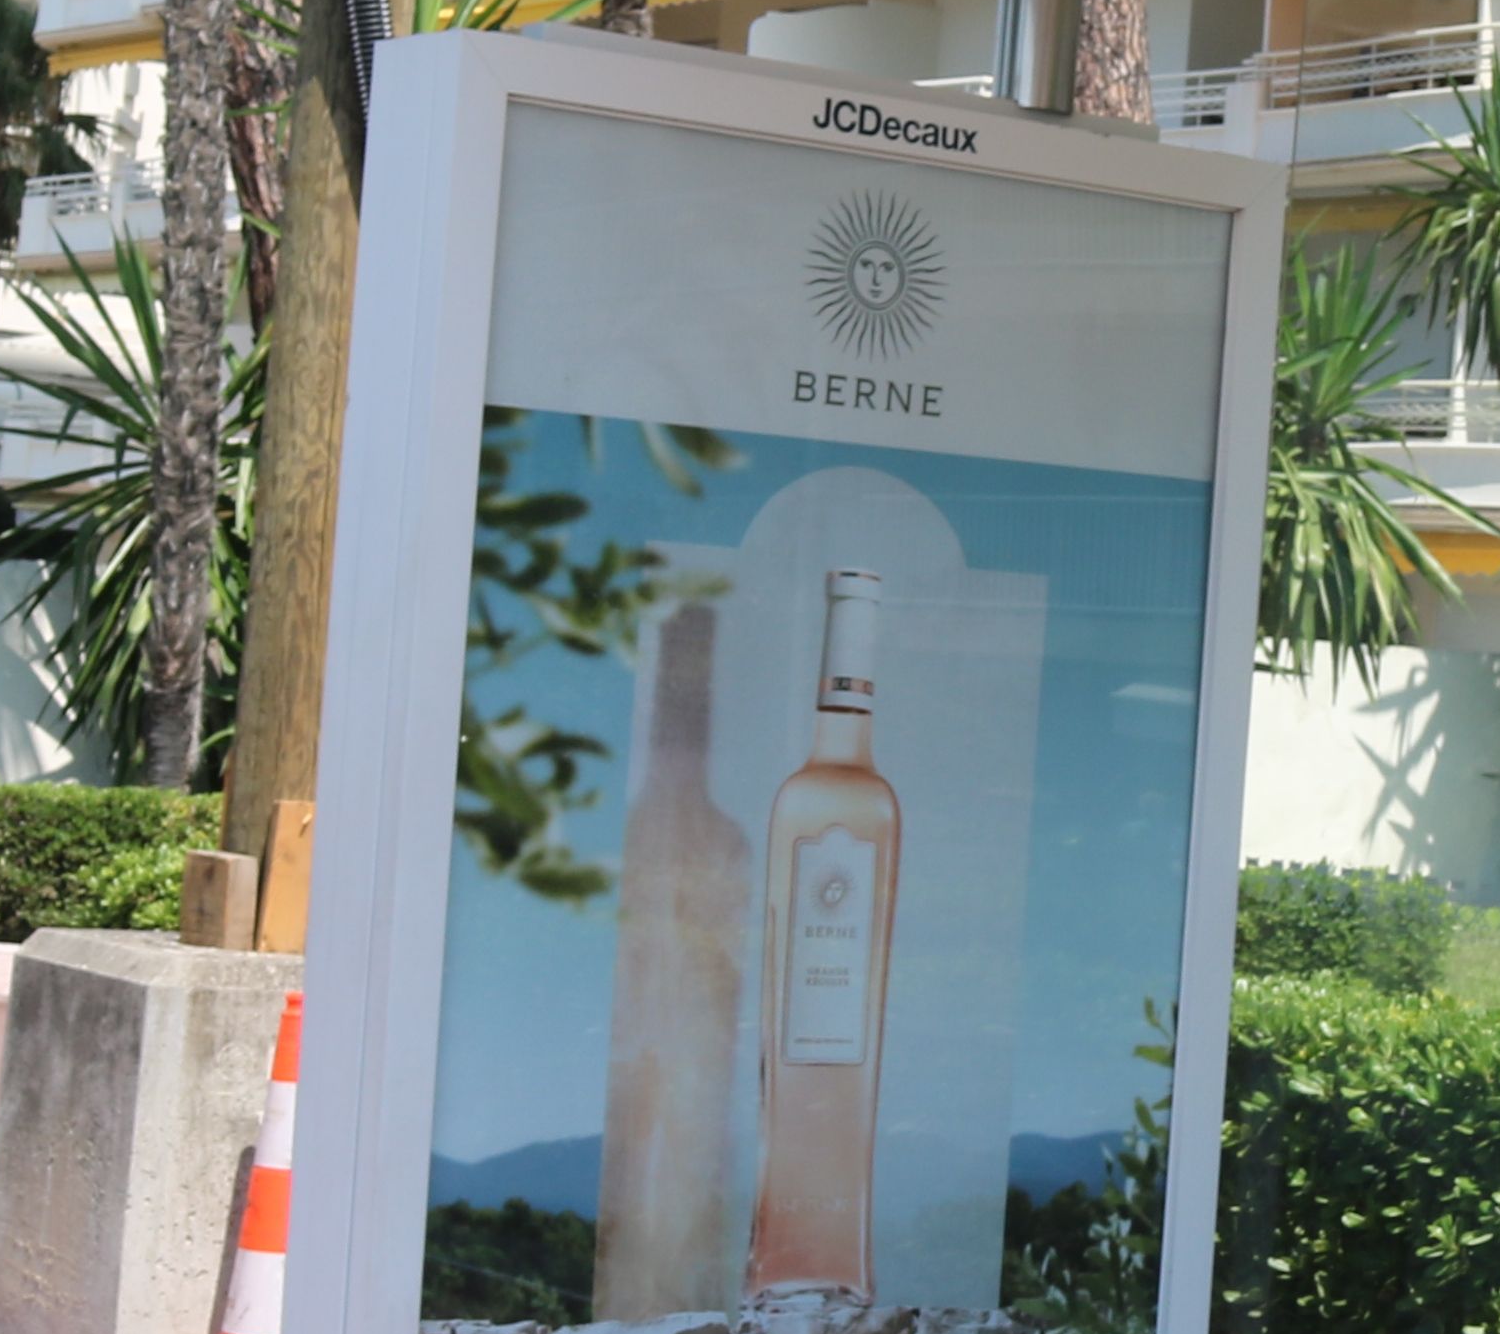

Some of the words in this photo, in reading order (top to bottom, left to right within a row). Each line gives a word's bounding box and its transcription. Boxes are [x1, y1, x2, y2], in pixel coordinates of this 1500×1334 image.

[812, 97, 977, 154] JCDecaux
[793, 370, 945, 418] BERNE
[804, 925, 859, 940] BERNE
